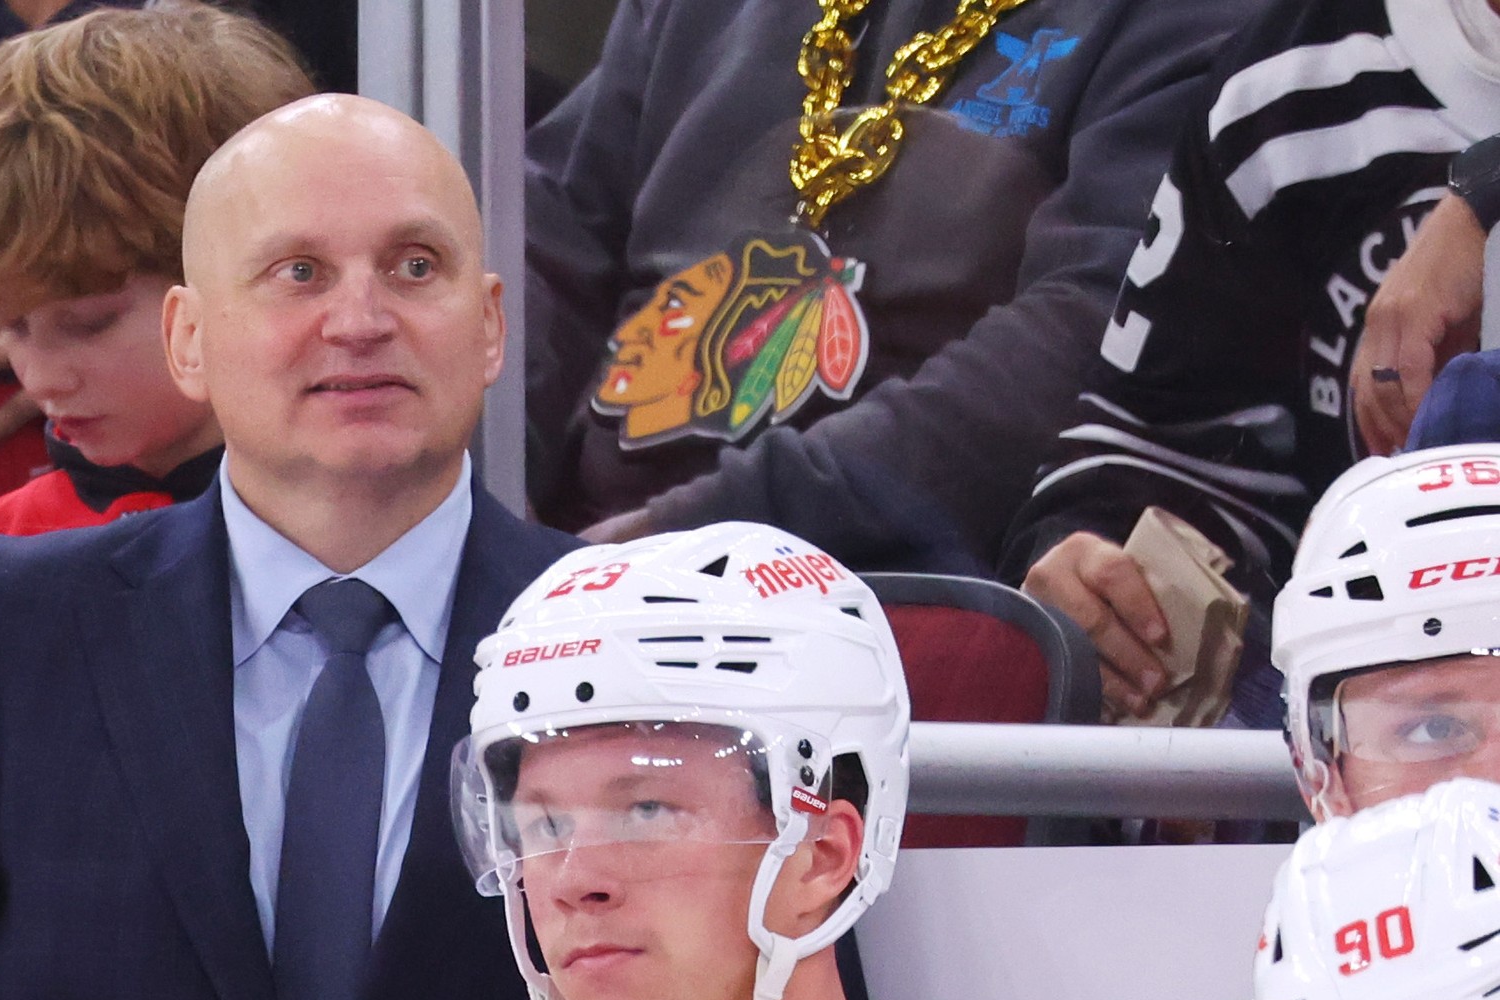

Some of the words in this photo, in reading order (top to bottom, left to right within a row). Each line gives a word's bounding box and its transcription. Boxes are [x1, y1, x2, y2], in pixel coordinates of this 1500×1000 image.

[543, 562, 630, 600] 23
[1407, 556, 1500, 591] CC
[503, 638, 602, 668] BAUER
[792, 789, 827, 812] BAUER
[1333, 904, 1416, 977] 90
